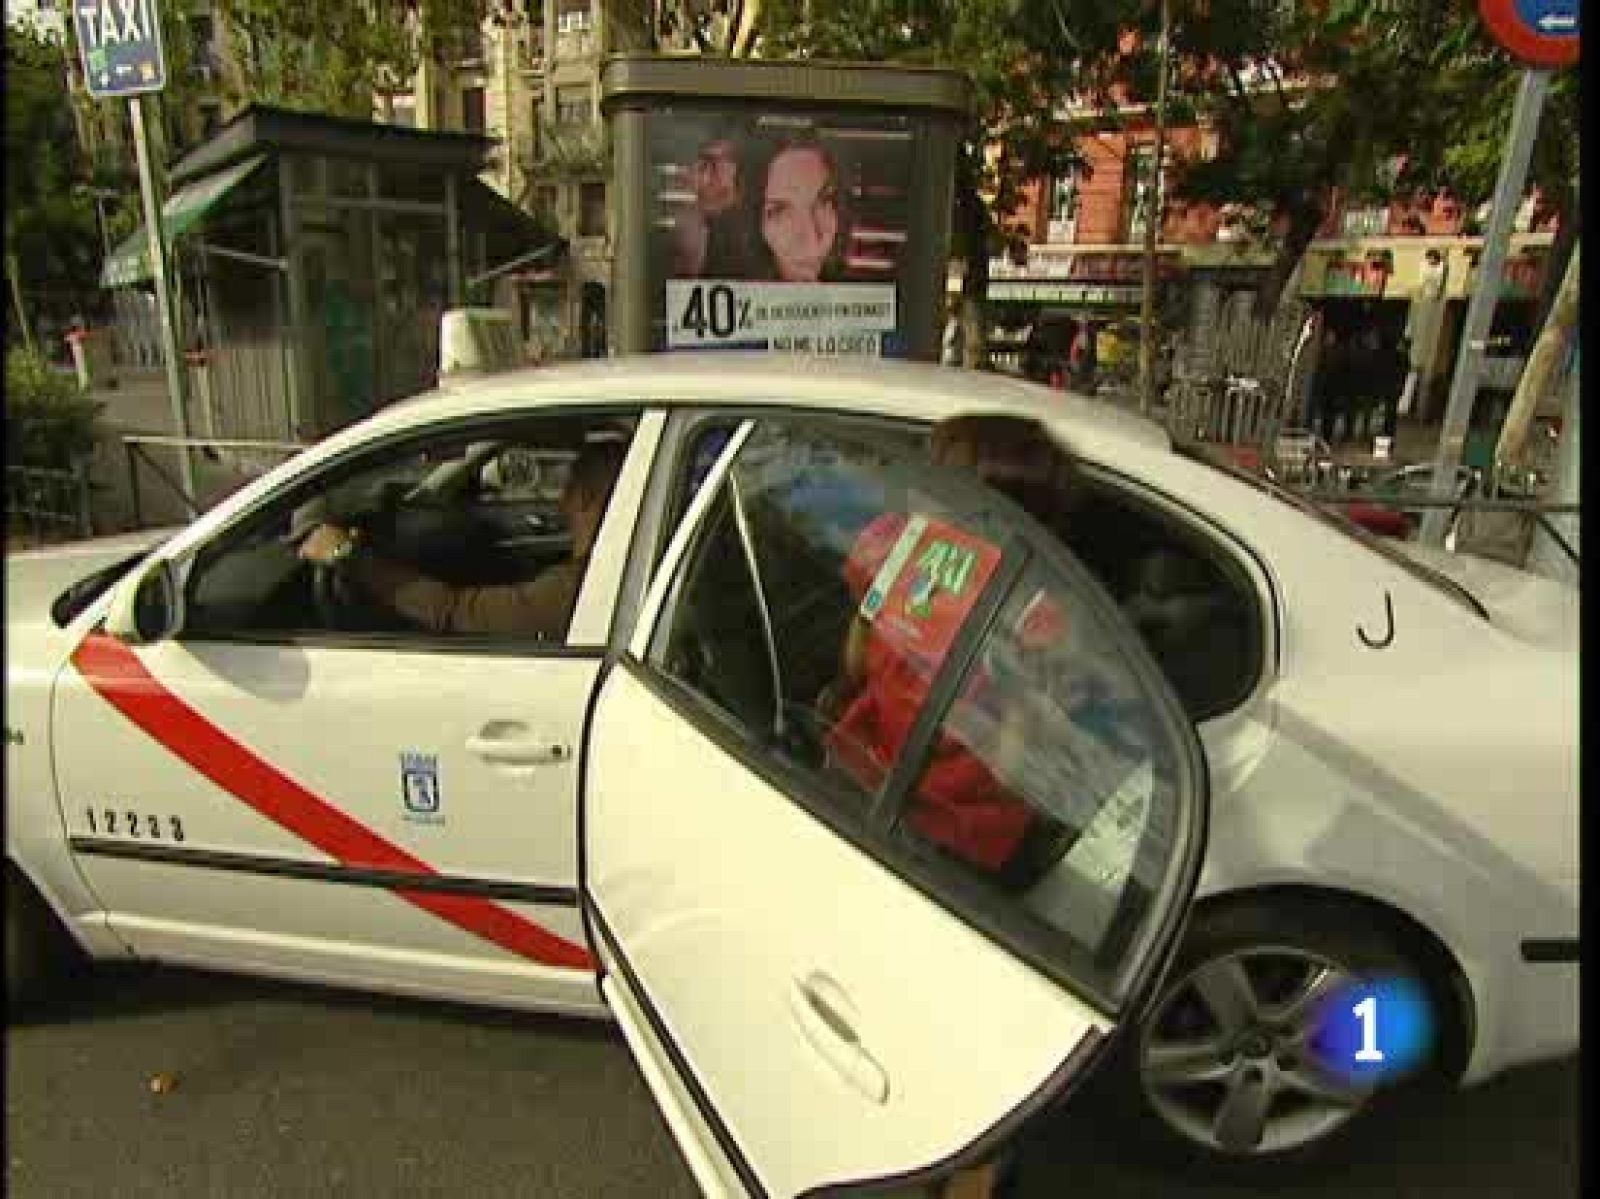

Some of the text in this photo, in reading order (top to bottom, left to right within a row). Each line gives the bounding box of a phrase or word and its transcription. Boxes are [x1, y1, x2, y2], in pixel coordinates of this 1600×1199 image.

[79, 0, 152, 46] TAXI
[681, 285, 753, 338] 40%
[1355, 590, 1394, 650] J
